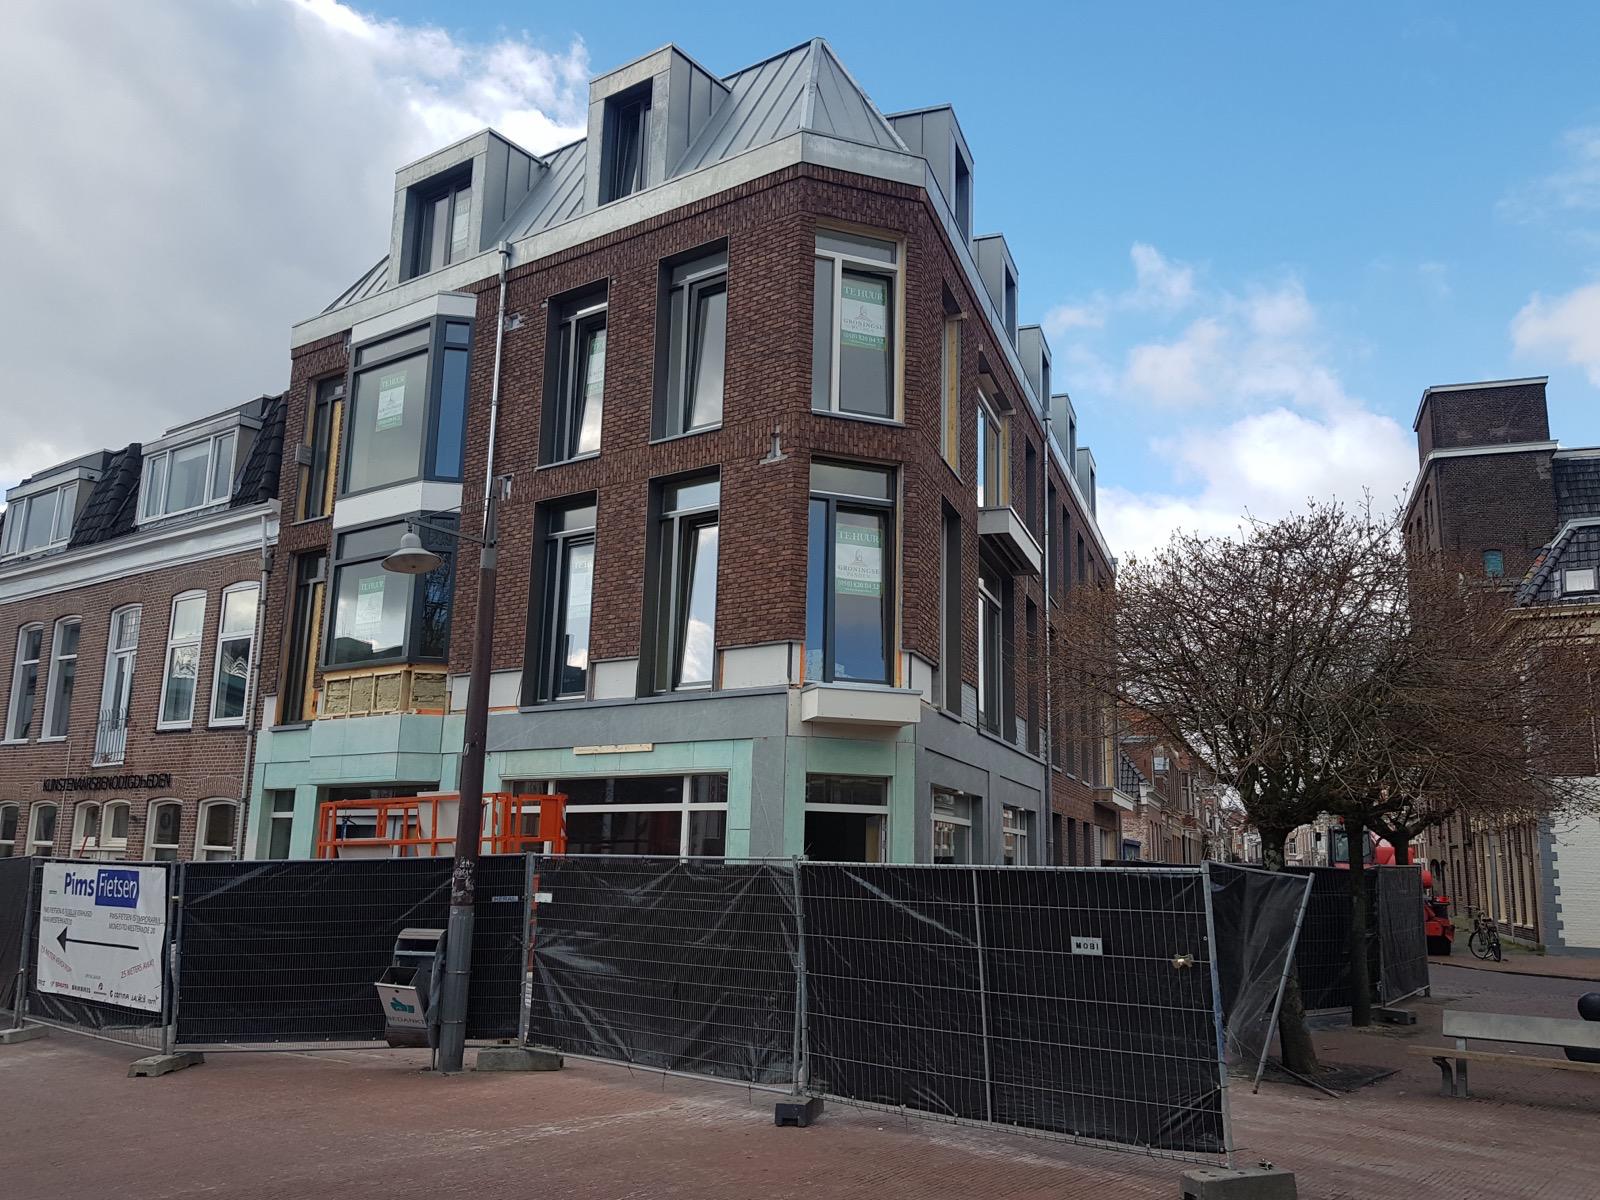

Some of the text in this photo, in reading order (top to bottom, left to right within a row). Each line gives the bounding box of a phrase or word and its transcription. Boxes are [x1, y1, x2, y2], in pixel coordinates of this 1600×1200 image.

[845, 287, 883, 300] TE HUUR
[840, 530, 880, 544] TE HUUR
[64, 872, 137, 899] Pims Fietsen
[1076, 942, 1098, 950] MOBI
